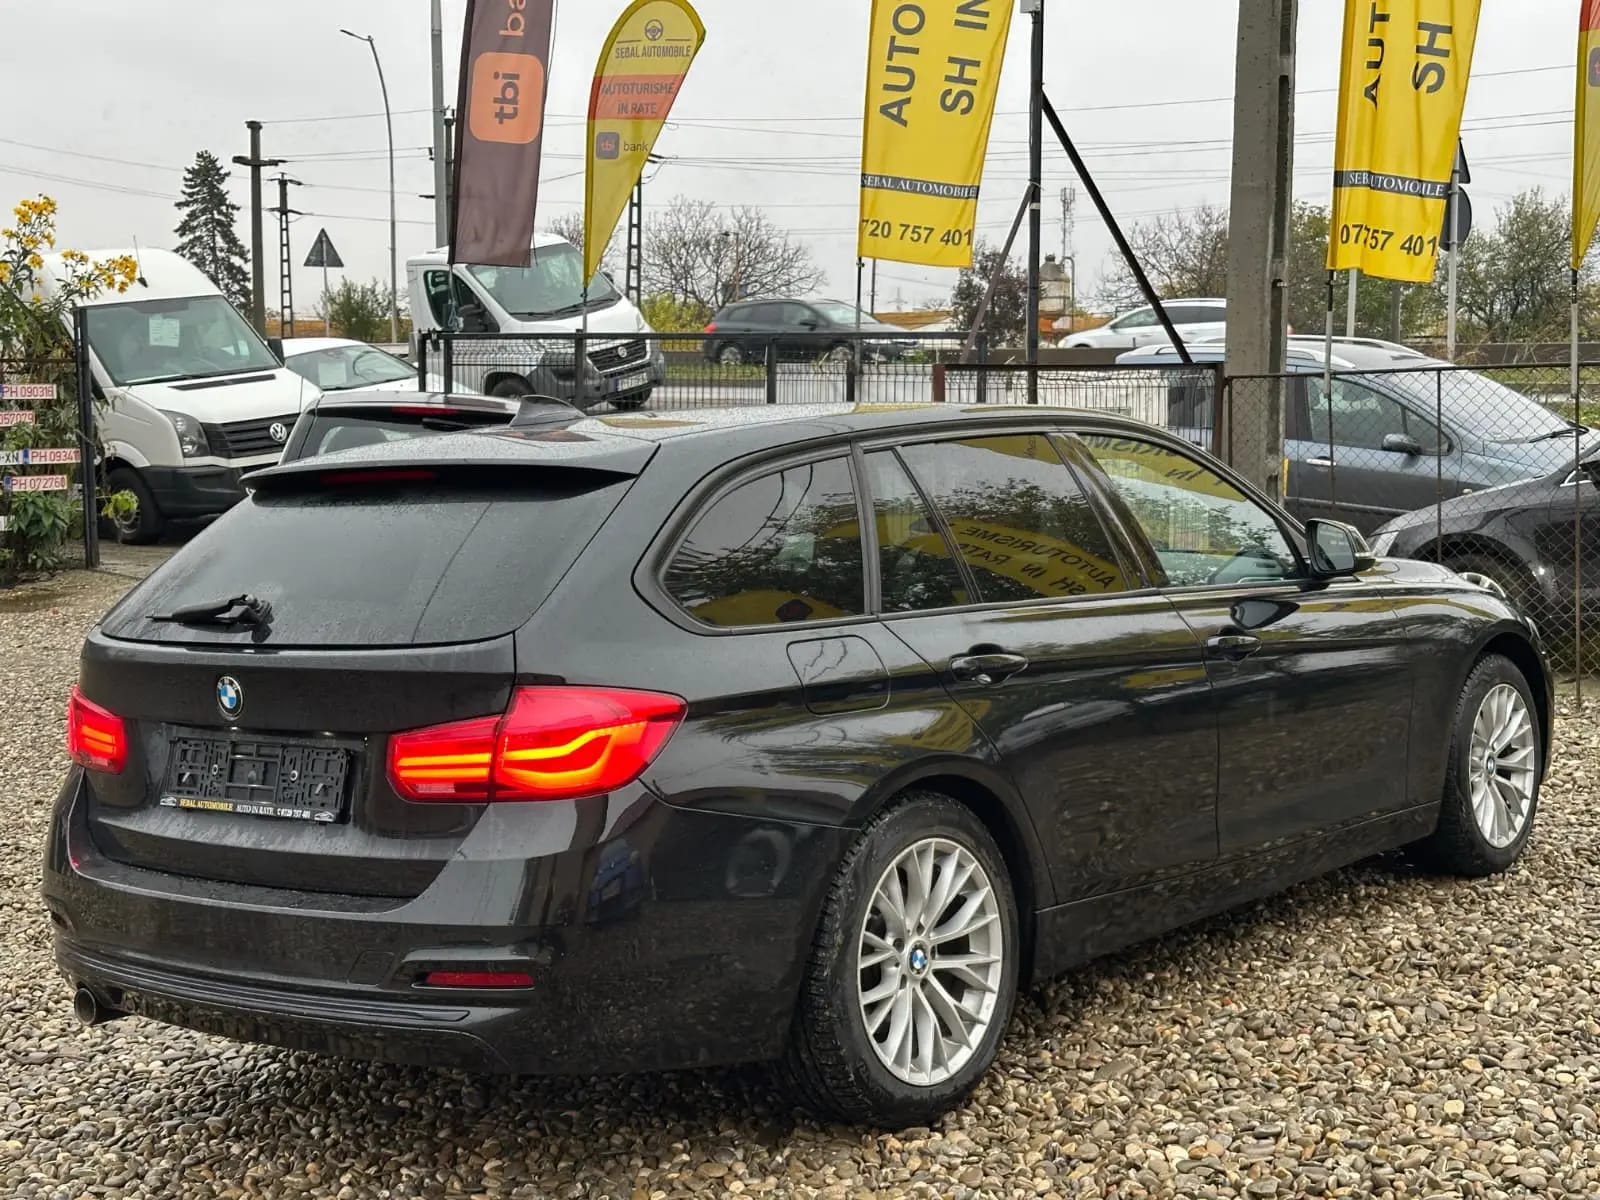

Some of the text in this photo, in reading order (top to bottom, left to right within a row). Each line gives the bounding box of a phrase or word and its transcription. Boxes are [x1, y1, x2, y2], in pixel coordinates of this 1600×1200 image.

[615, 45, 691, 59] SEBAL AUTOMOBILE
[1364, 1, 1391, 112] AUT
[1412, 21, 1452, 94] SH
[880, 4, 925, 127] AUTO
[602, 82, 675, 95] AUTOTURISME
[940, 56, 980, 115] SH
[493, 71, 520, 124] tbi
[617, 102, 657, 114] IN RATE
[623, 141, 649, 153] bank
[897, 180, 978, 198] AUTOMOBILE
[899, 223, 935, 244] 757
[940, 229, 973, 247] 401
[1400, 234, 1437, 257] 401
[3, 386, 18, 398] PH
[31, 451, 47, 463] PH
[11, 478, 27, 490] PH
